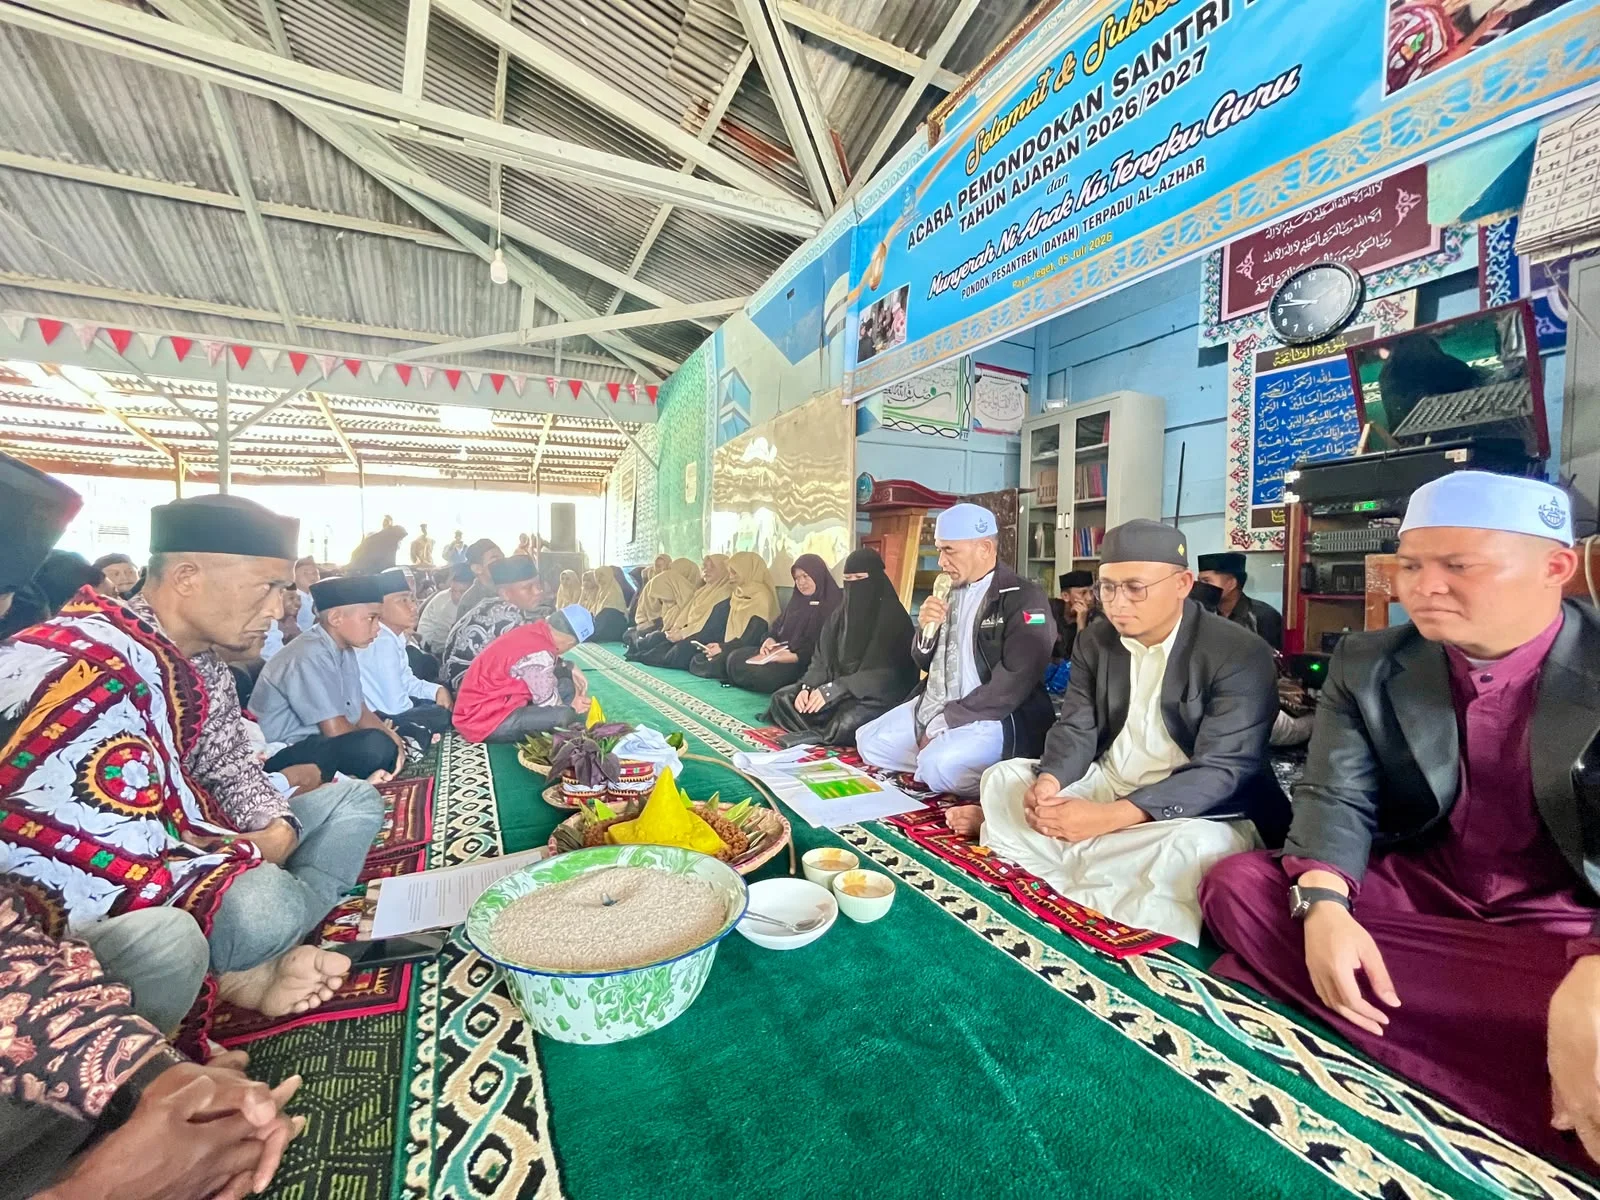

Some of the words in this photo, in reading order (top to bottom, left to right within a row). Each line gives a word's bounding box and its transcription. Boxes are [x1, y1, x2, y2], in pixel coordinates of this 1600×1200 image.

[965, 67, 1054, 176] Selamat
[1053, 51, 1077, 93] &
[1083, 0, 1180, 76] Sukse
[908, 201, 954, 250] ACARA
[958, 85, 1103, 212] PEMONDOKAN
[1113, 0, 1230, 98] SANTRI
[960, 187, 1006, 233] TAHUN
[1011, 135, 1080, 199] AJARAN
[1087, 45, 1208, 148] 2026/2027
[927, 240, 996, 300] Munyerah
[1017, 189, 1075, 246] Anak
[1074, 169, 1110, 213] Ku
[1110, 119, 1204, 193] Tengku
[1204, 64, 1303, 139] Guru
[1046, 173, 1069, 195] dan
[961, 276, 990, 300] PONDOK
[992, 247, 1039, 283] PESANTREN
[1041, 225, 1079, 258] (DAYAH)
[1082, 195, 1134, 233] TERPADU
[1137, 157, 1206, 204] AL-AZHAR
[1070, 245, 1087, 260] Juli
[1089, 231, 1114, 252] 2026
[1293, 280, 1302, 290] 11
[1307, 272, 1317, 281] 12
[1284, 292, 1293, 301] 10
[1277, 307, 1284, 316] 9
[1293, 323, 1299, 332] 7
[1307, 323, 1314, 332] 6
